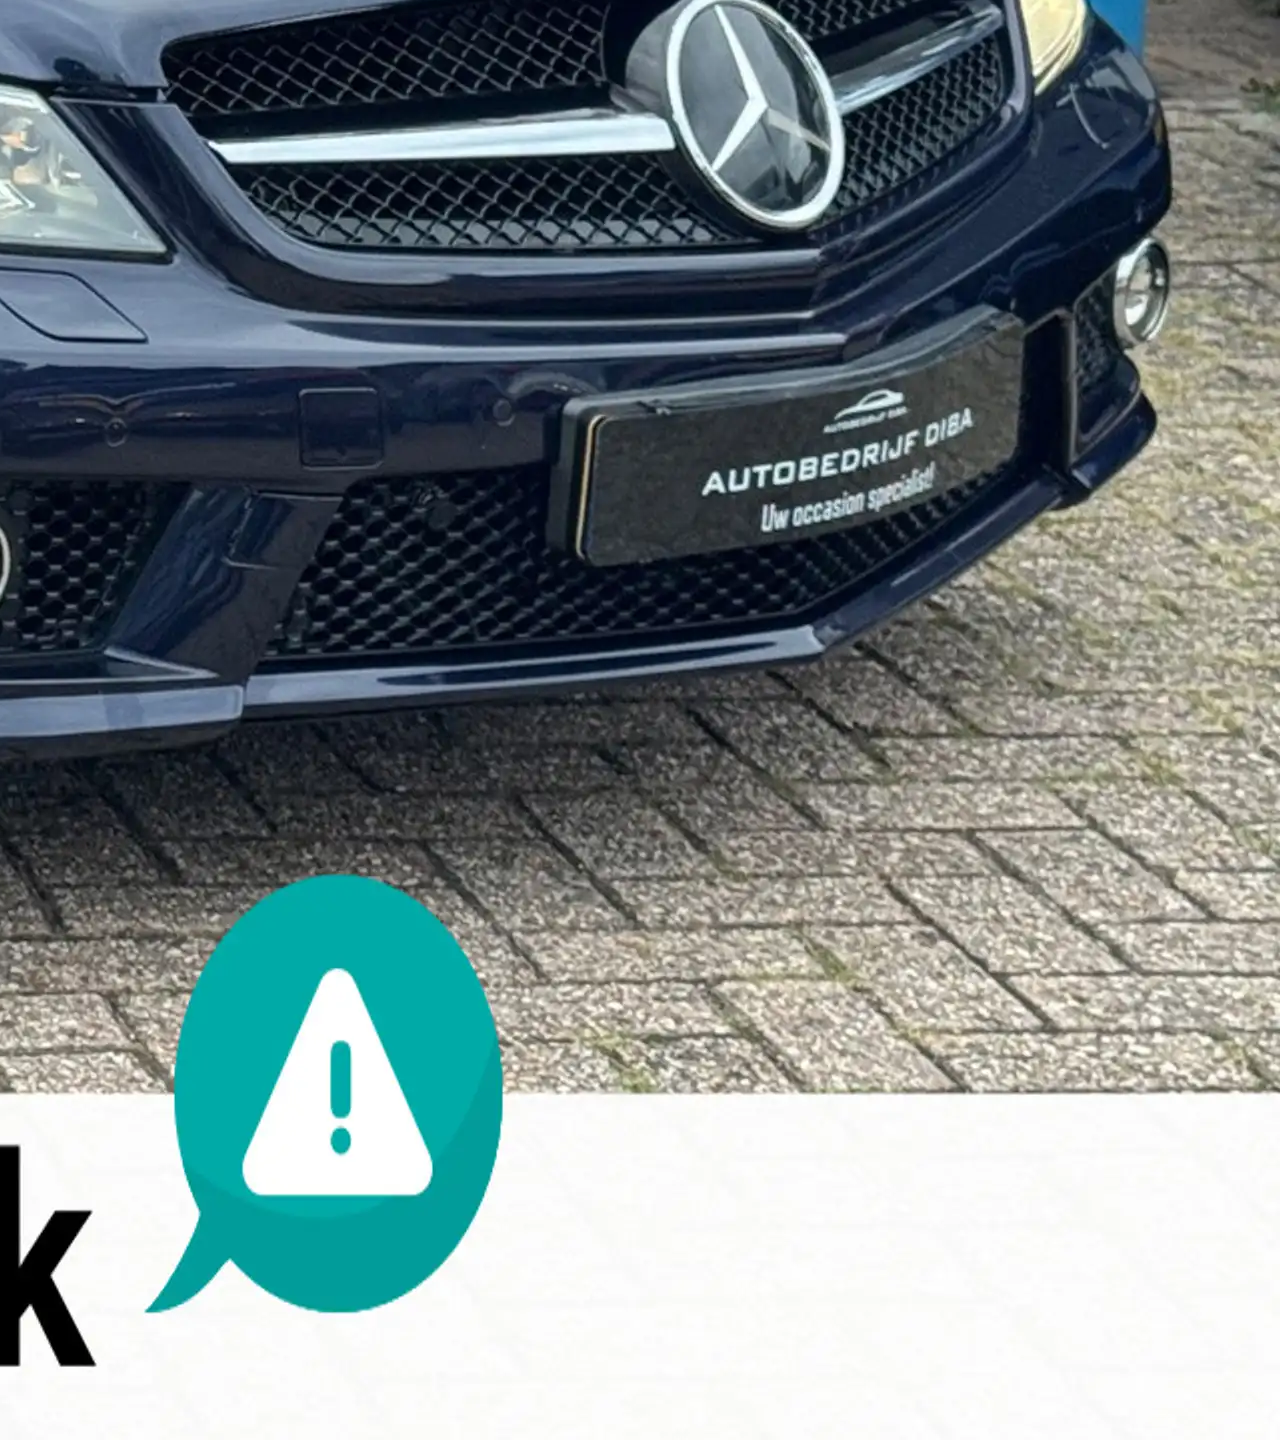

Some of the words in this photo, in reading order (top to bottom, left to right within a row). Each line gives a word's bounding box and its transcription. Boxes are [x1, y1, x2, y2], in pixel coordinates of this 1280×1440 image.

[701, 429, 921, 496] AUTOBEDRIJF
[924, 407, 974, 448] DIBA
[761, 503, 790, 533] Uw
[792, 490, 866, 527] occasion
[868, 461, 937, 513] specialist!
